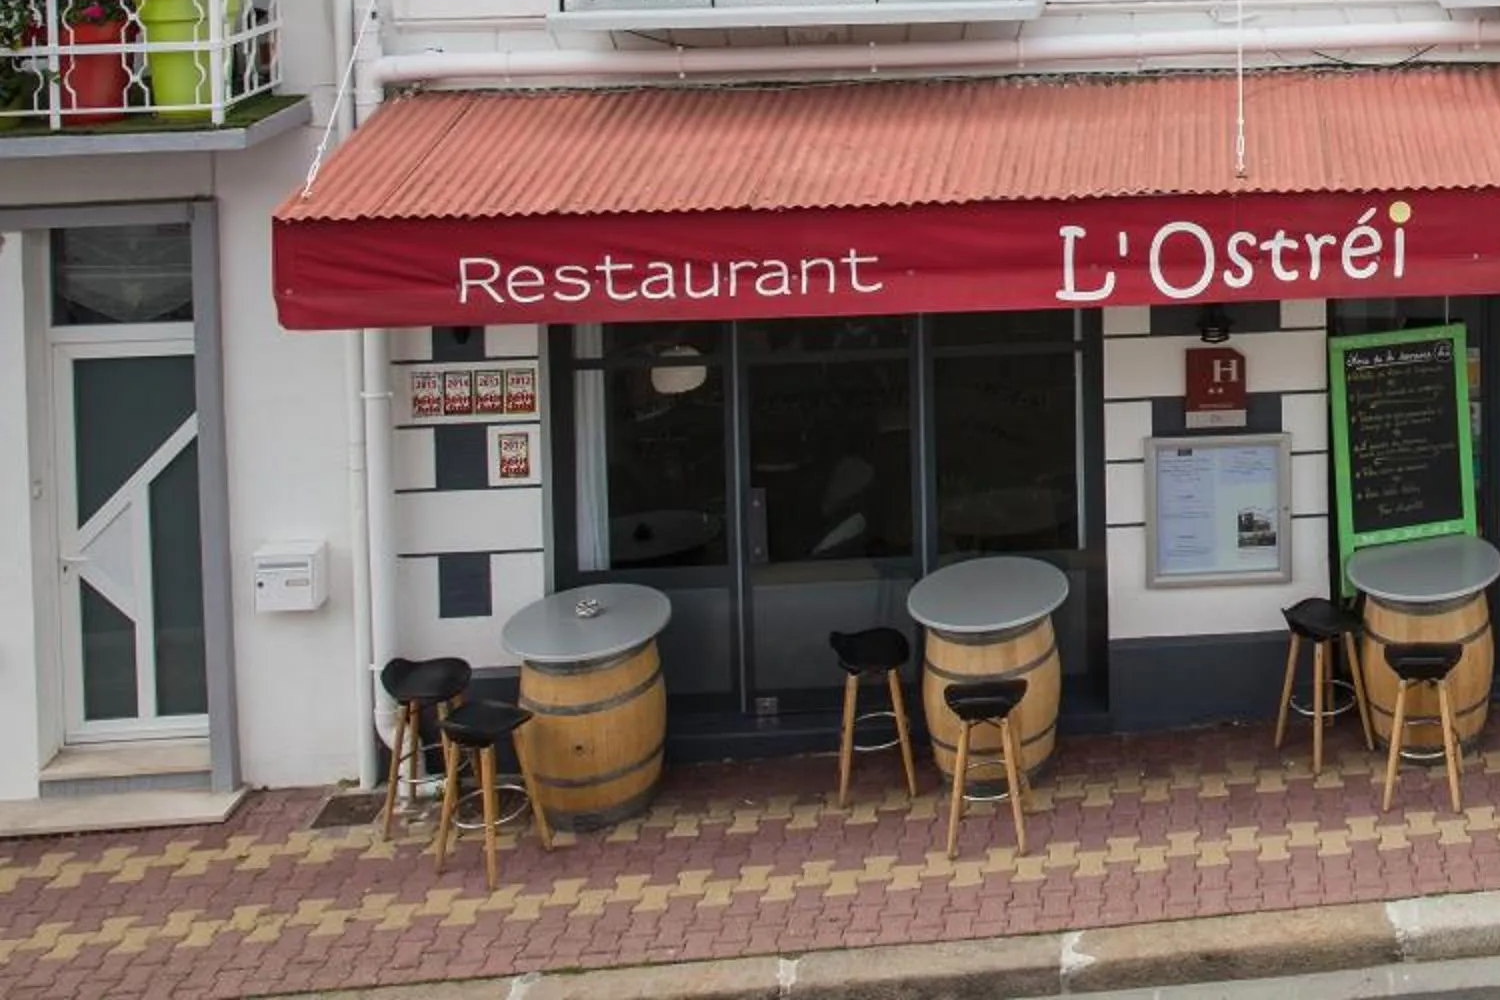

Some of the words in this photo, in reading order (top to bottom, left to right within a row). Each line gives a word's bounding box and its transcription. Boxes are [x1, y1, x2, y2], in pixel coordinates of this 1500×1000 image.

[459, 248, 883, 304] Restaurant
[1055, 200, 1412, 302] L'Ostréi
[1213, 359, 1238, 382] H
